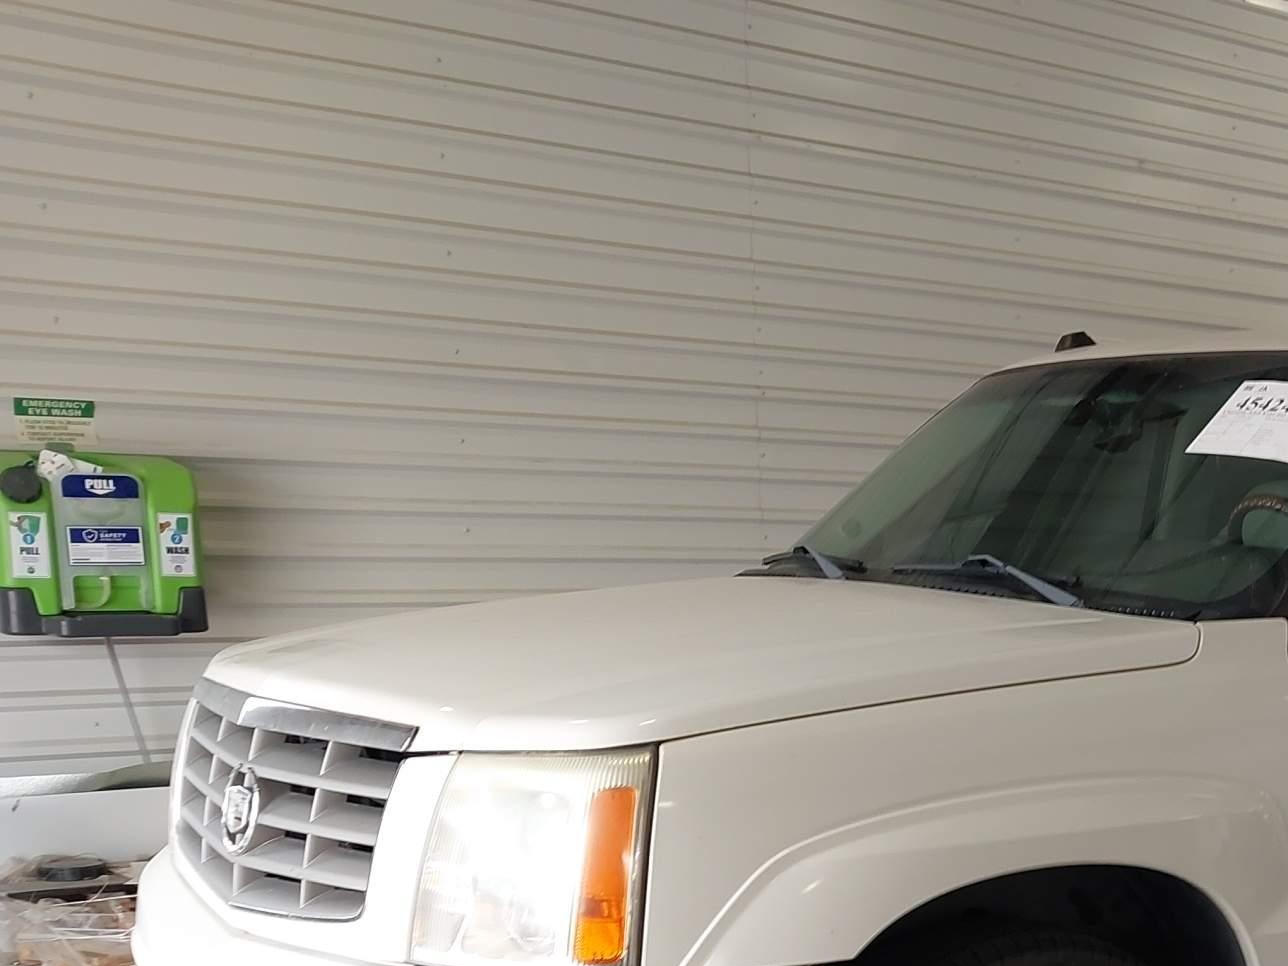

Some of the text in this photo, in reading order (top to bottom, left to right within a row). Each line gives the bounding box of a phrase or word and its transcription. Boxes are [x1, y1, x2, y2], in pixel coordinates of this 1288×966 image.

[22, 399, 87, 409] EMERGENCY
[28, 407, 82, 417] EYE WASH
[84, 479, 116, 490] PULL
